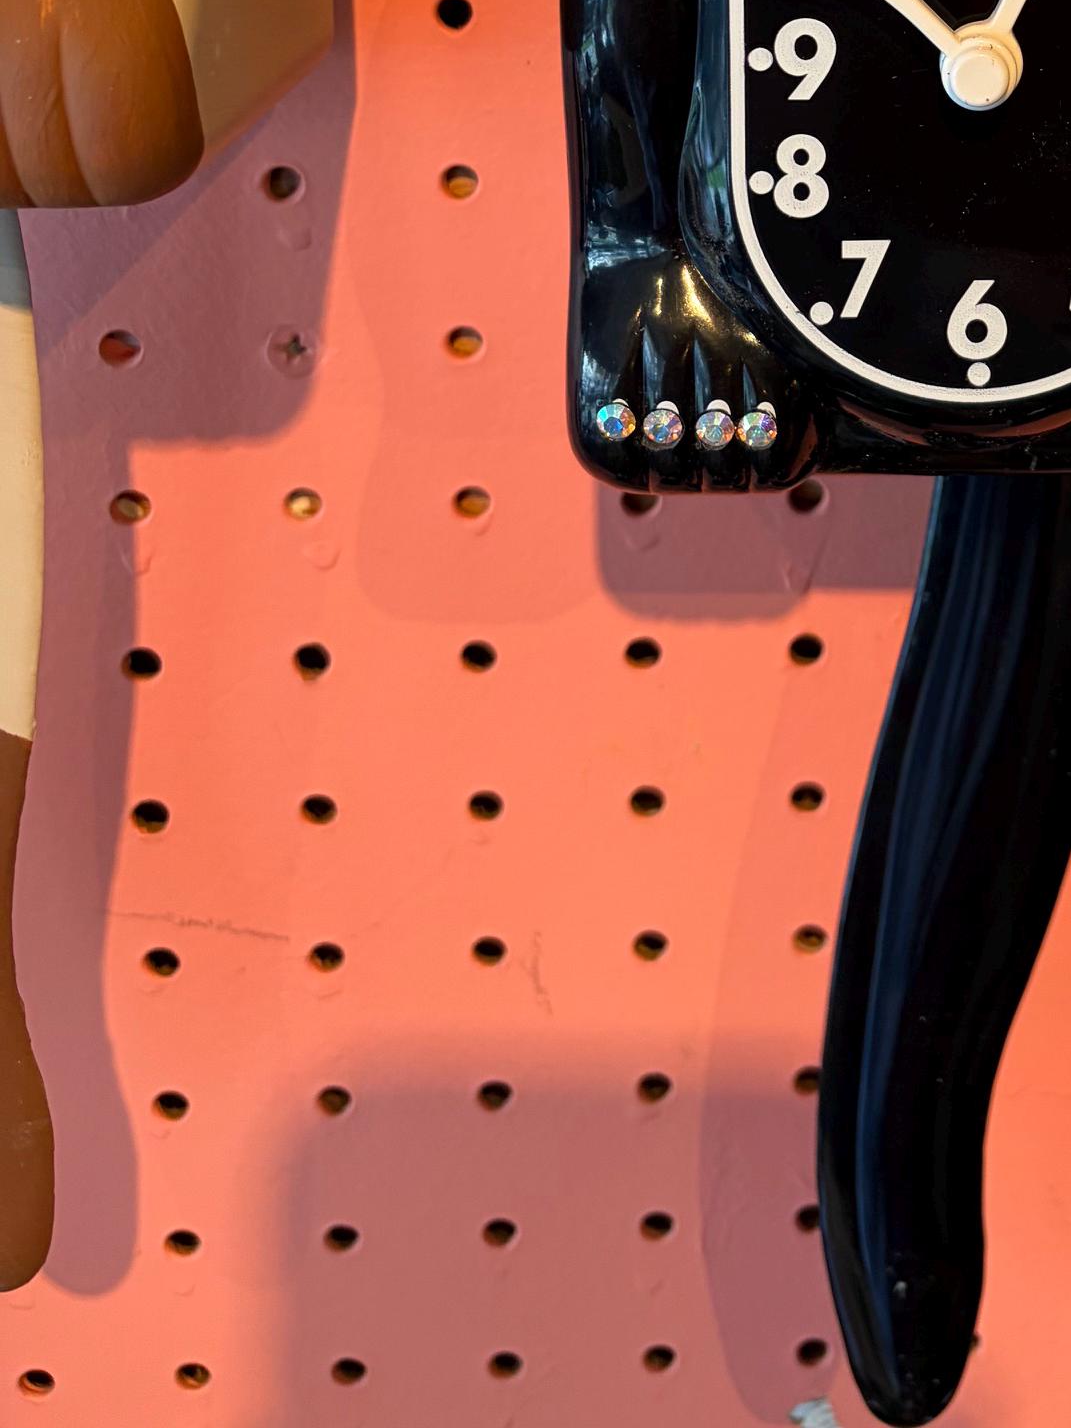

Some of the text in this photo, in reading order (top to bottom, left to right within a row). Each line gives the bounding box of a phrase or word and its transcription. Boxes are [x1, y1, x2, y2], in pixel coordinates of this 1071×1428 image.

[773, 17, 837, 101] 9
[773, 133, 830, 219] 8
[840, 239, 892, 318] 7
[946, 279, 1008, 360] 6
